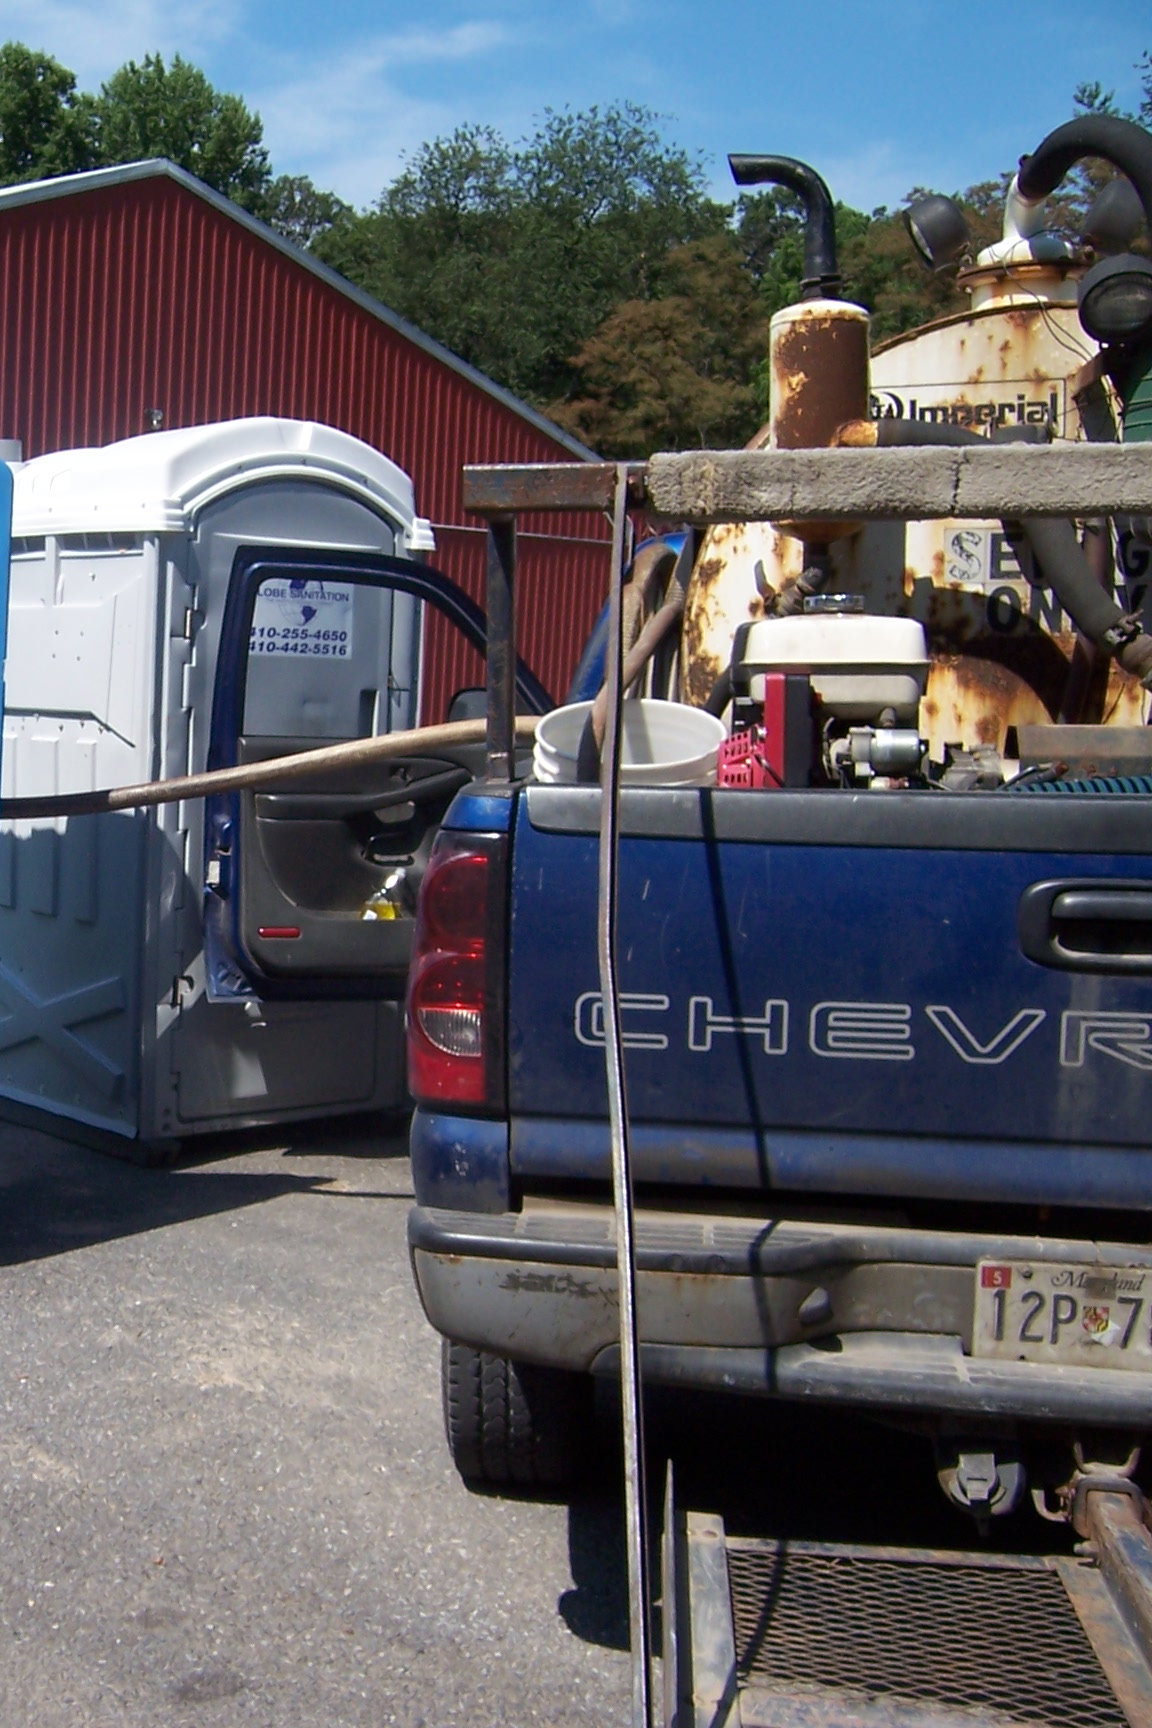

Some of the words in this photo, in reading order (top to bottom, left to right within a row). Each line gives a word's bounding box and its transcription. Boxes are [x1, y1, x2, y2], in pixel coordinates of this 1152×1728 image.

[910, 393, 1058, 427] Imperial
[257, 587, 287, 599] LOBE
[290, 590, 350, 602] SANITATION
